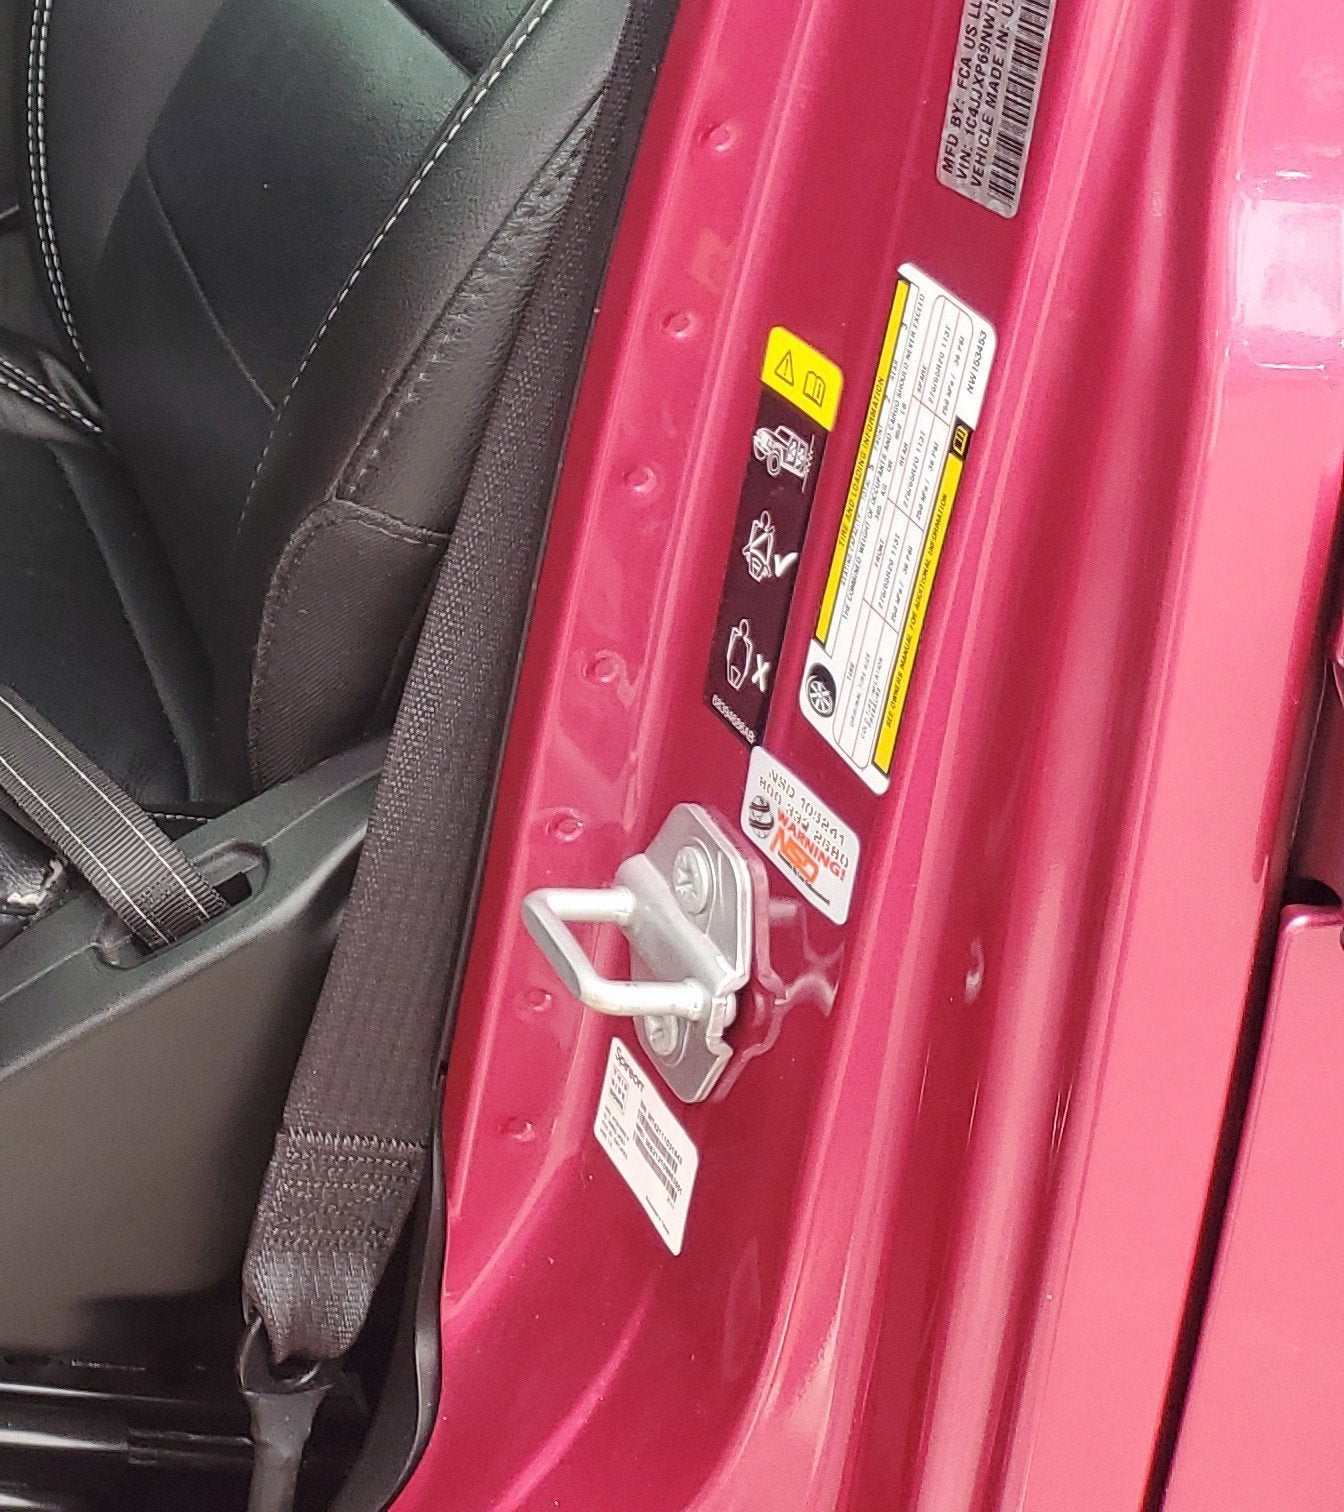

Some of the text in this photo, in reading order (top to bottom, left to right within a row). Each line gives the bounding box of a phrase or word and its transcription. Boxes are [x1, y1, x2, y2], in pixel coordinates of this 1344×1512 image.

[963, 23, 978, 51] US
[994, 22, 1009, 50] IN:
[956, 54, 972, 91] FCA
[985, 53, 1004, 109] MADE
[949, 96, 964, 129] BY:
[942, 131, 958, 175] MFD
[956, 142, 972, 181] VIN:
[971, 112, 993, 189] VEHICLE
[966, 328, 987, 395] NW153453
[838, 374, 884, 548] TIRE AND LOADING INFORMATION
[775, 806, 846, 885] WARNING!
